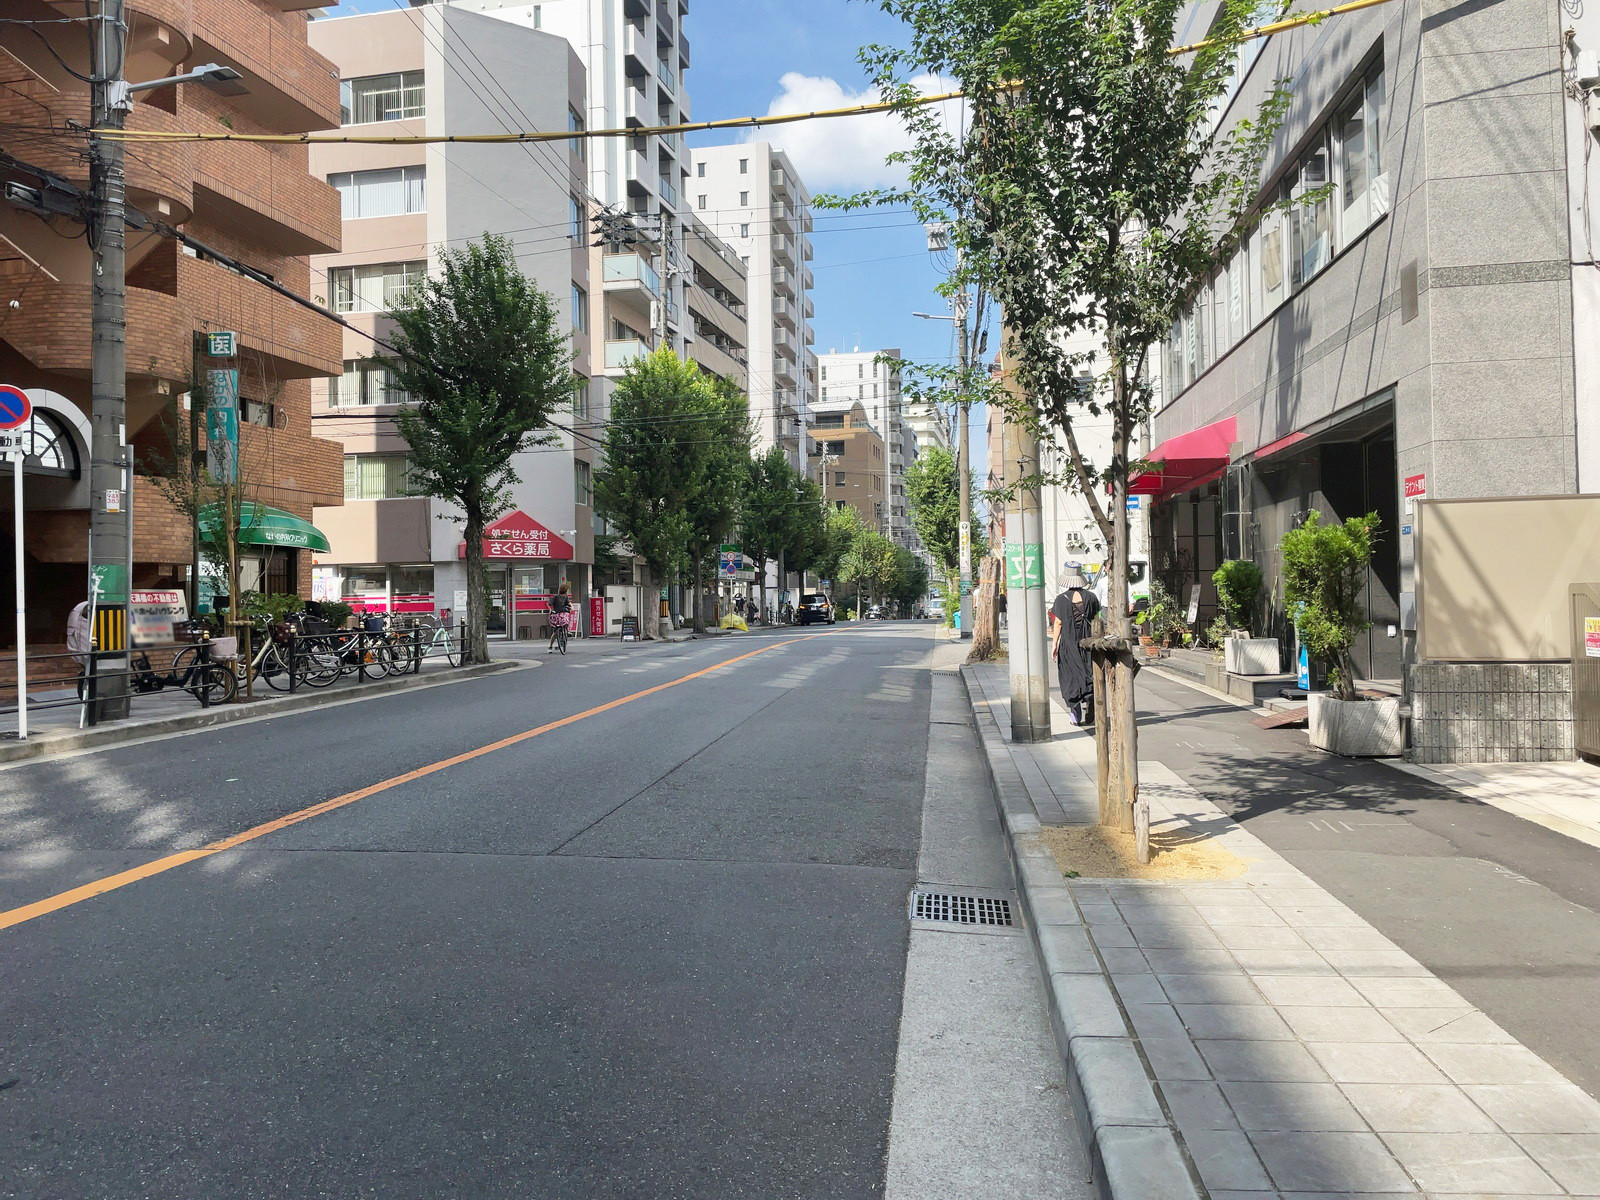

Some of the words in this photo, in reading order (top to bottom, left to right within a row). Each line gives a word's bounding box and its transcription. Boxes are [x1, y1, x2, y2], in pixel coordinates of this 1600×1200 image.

[210, 335, 230, 354] 医
[491, 529, 548, 540] 処方せん受付
[490, 542, 550, 556] さくら薬局
[1011, 556, 1037, 580] 文
